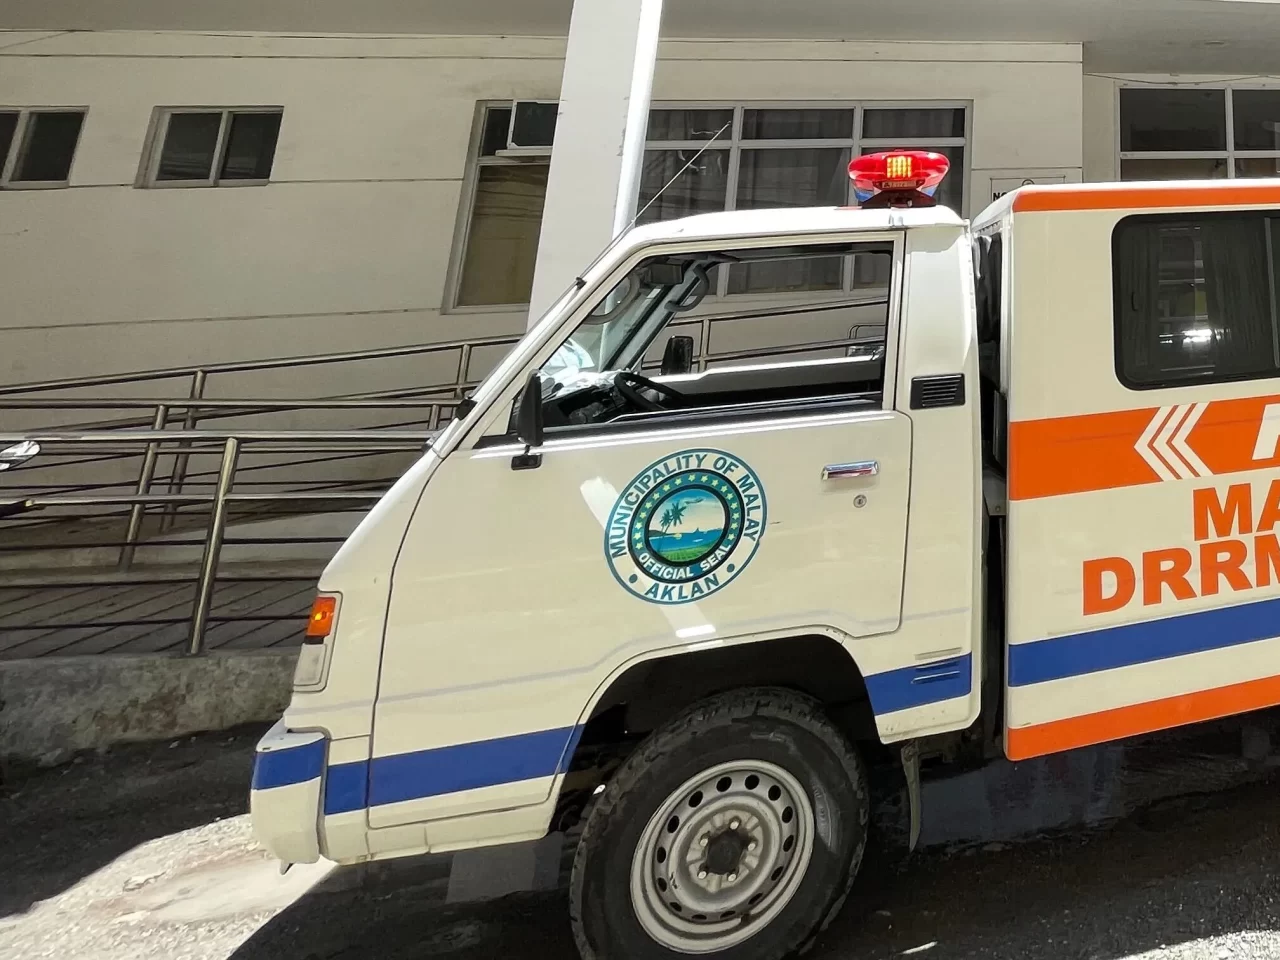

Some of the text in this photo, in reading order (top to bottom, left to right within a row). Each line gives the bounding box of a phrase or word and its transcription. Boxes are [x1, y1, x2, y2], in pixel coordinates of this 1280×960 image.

[609, 454, 761, 559] MUNICIPALITY OF MALAY
[638, 543, 732, 580] OFFICIAL SEAL
[644, 573, 720, 601] AKLAN
